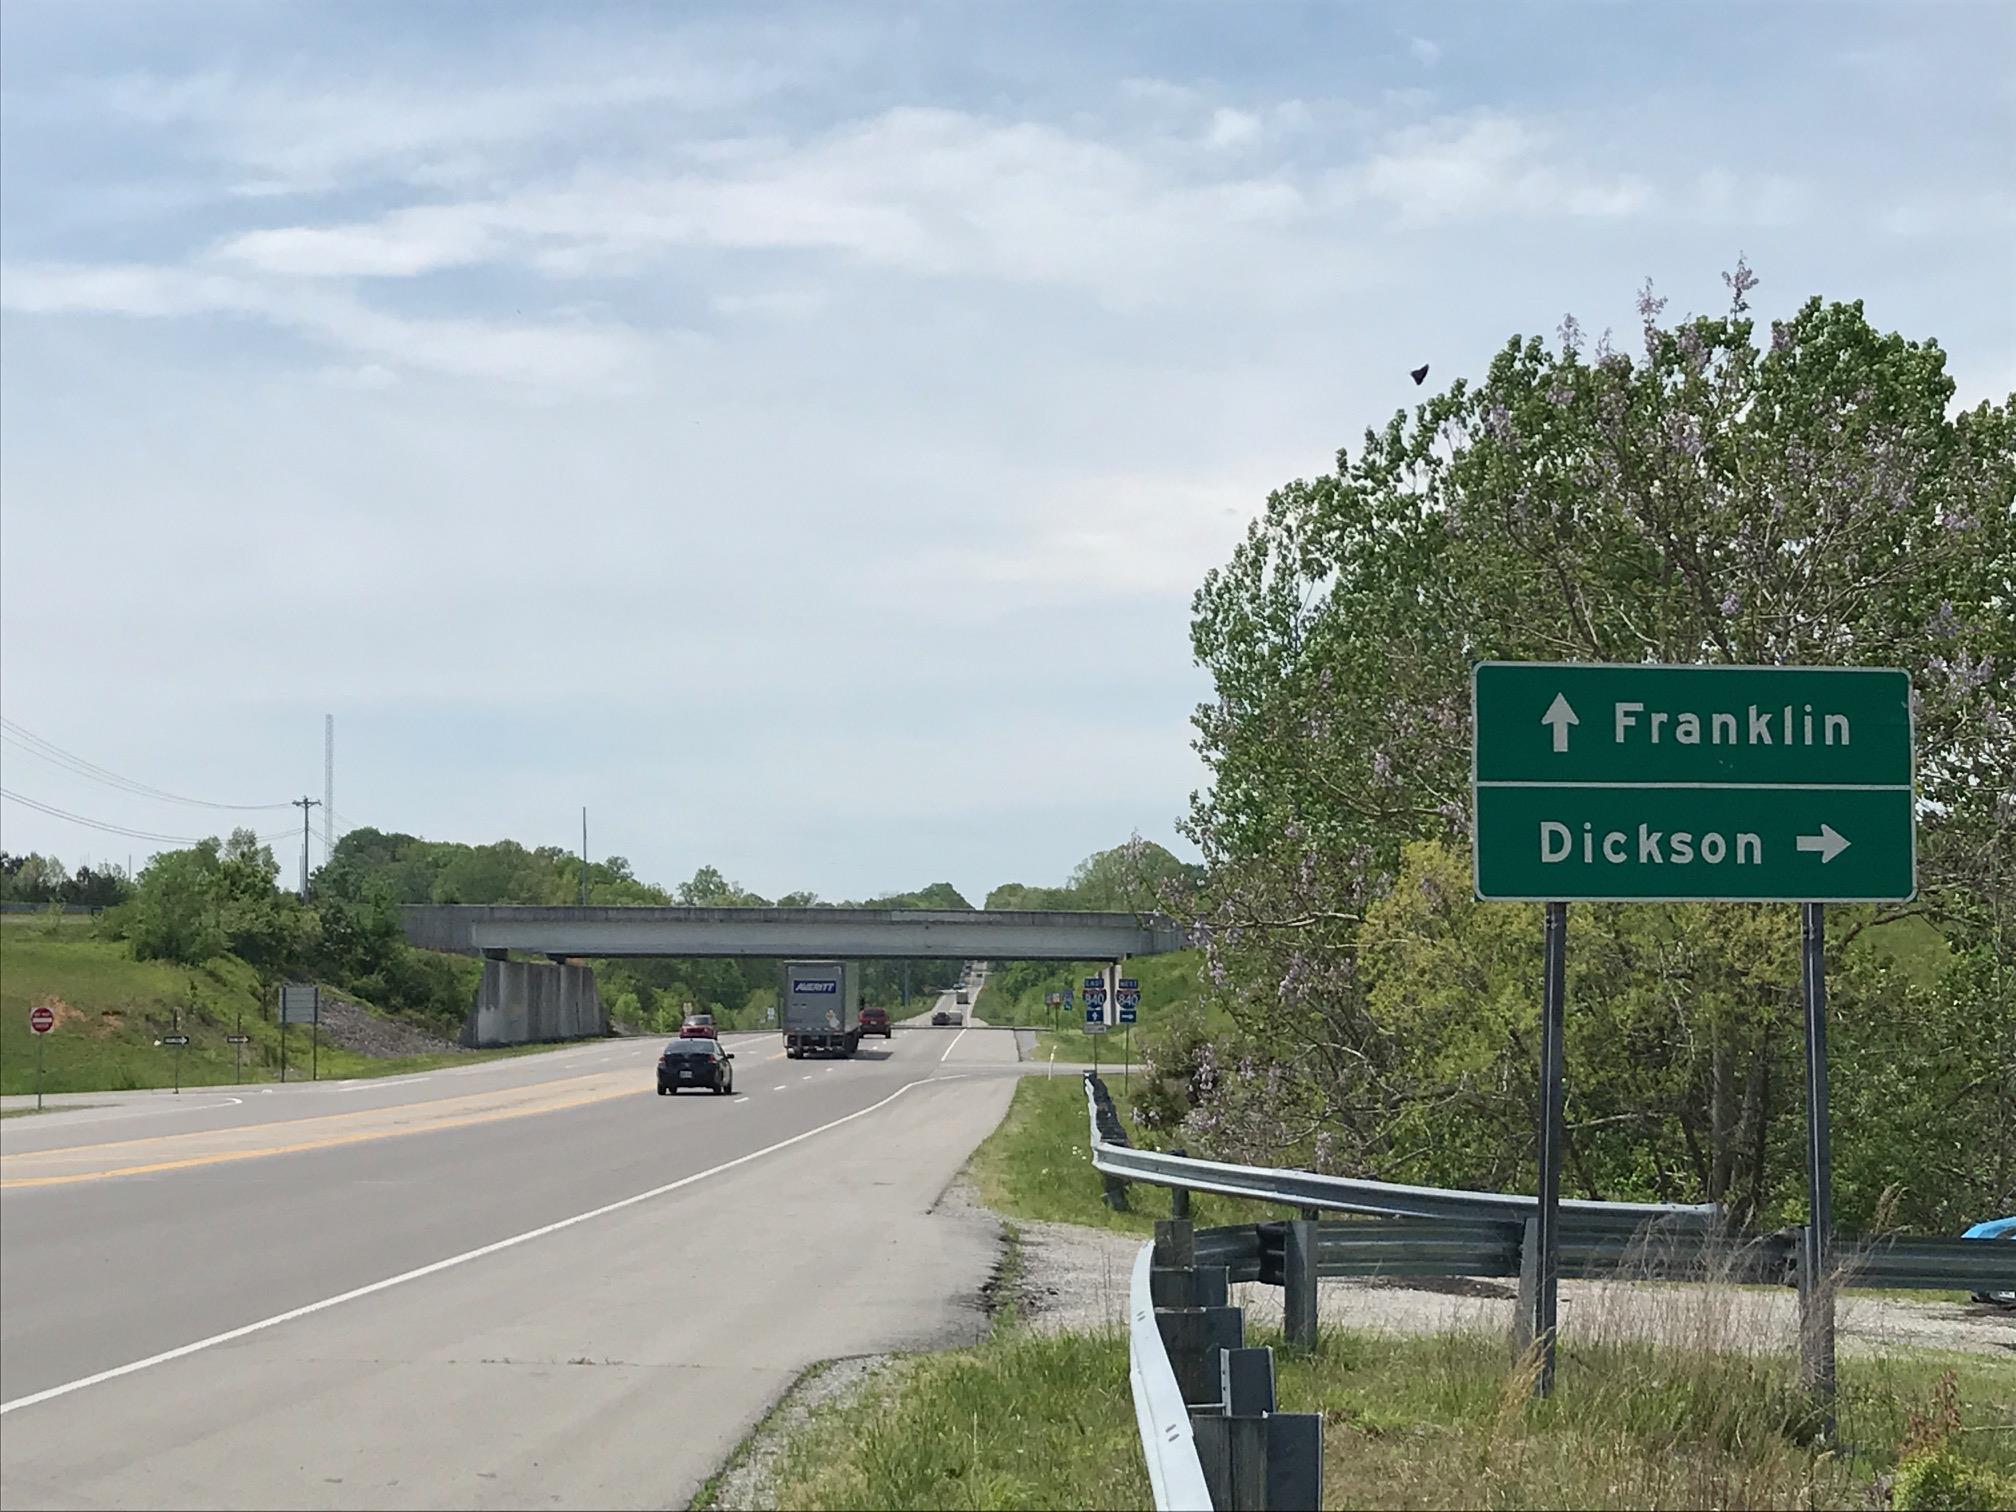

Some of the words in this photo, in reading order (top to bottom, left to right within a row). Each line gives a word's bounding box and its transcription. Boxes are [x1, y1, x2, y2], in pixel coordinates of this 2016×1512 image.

[1615, 702, 1851, 745] Franklin
[1540, 821, 1762, 865] Dickson
[1085, 993, 1104, 1005] 840
[1119, 994, 1138, 1005] 840
